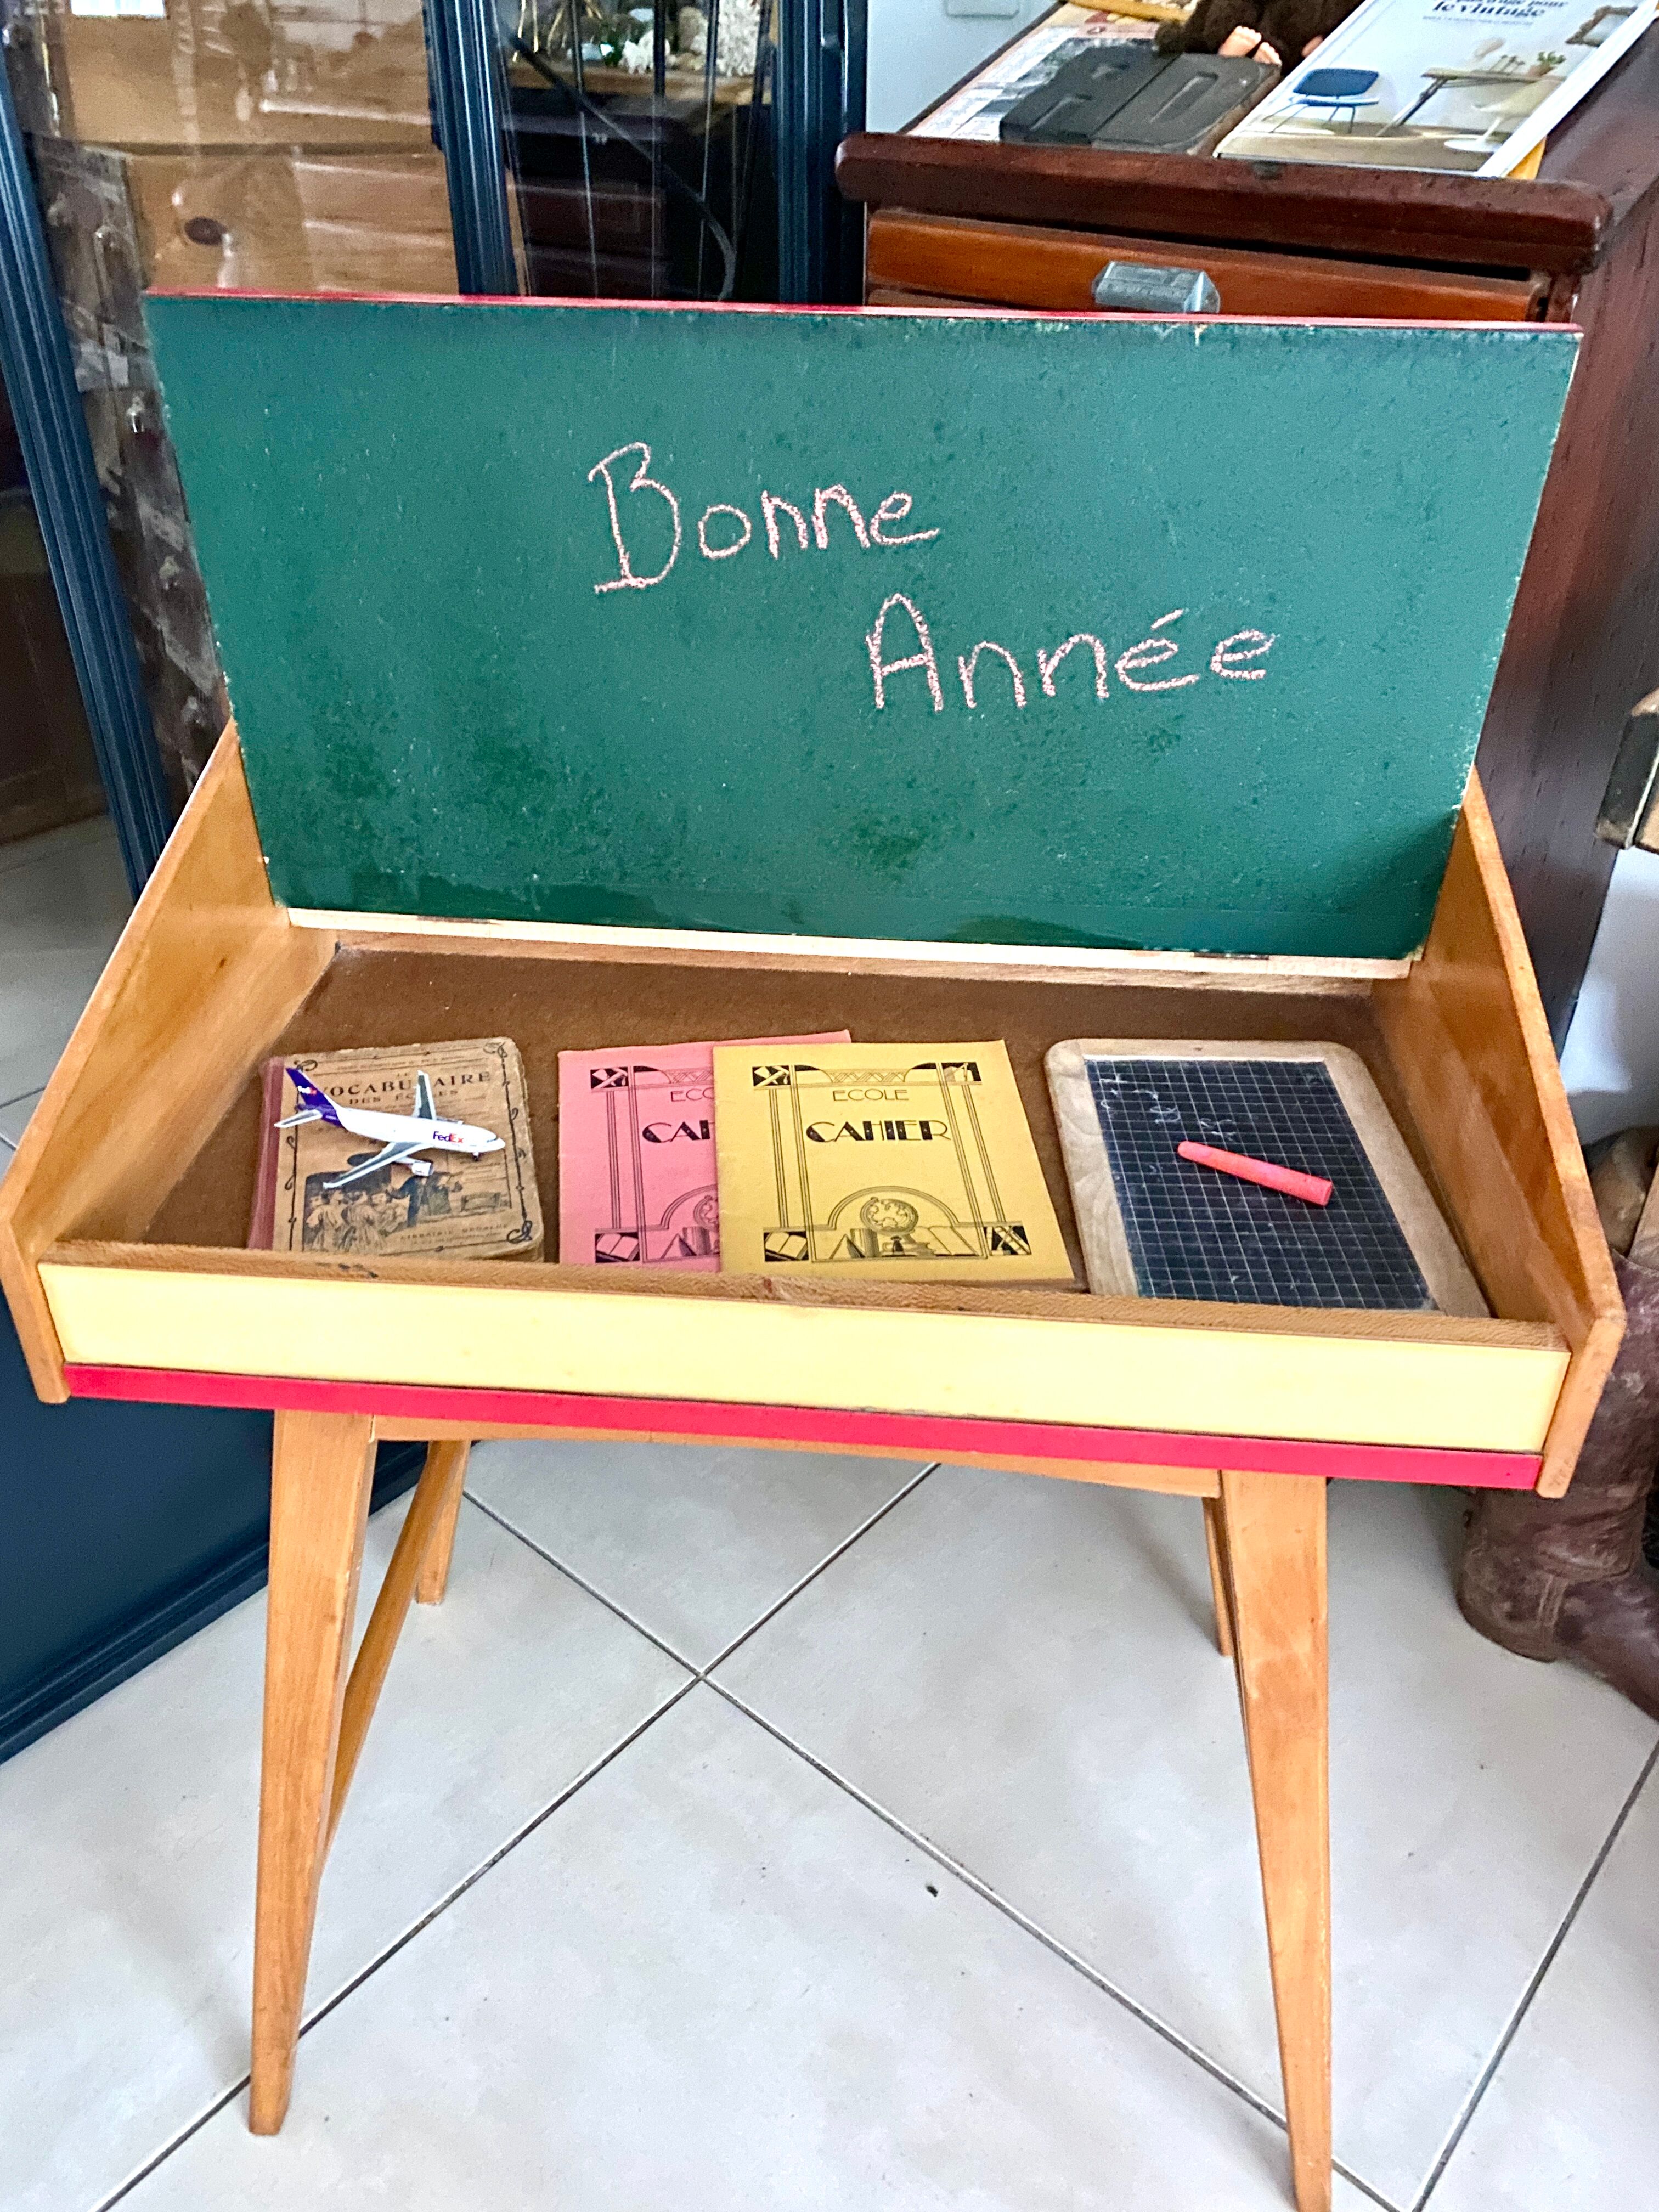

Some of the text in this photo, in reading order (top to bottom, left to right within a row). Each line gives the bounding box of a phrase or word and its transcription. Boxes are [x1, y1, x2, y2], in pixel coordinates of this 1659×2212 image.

[1432, 1, 1545, 17] le vintage
[588, 442, 940, 594] Bonne
[865, 592, 1278, 712] Année
[324, 1071, 490, 1096] OCABUAIRE
[670, 1087, 715, 1102] ECO
[833, 1088, 909, 1101] ECOLE
[433, 1131, 464, 1143] FedEx
[642, 1120, 715, 1143] CAH
[806, 1120, 951, 1143] CAHIER
